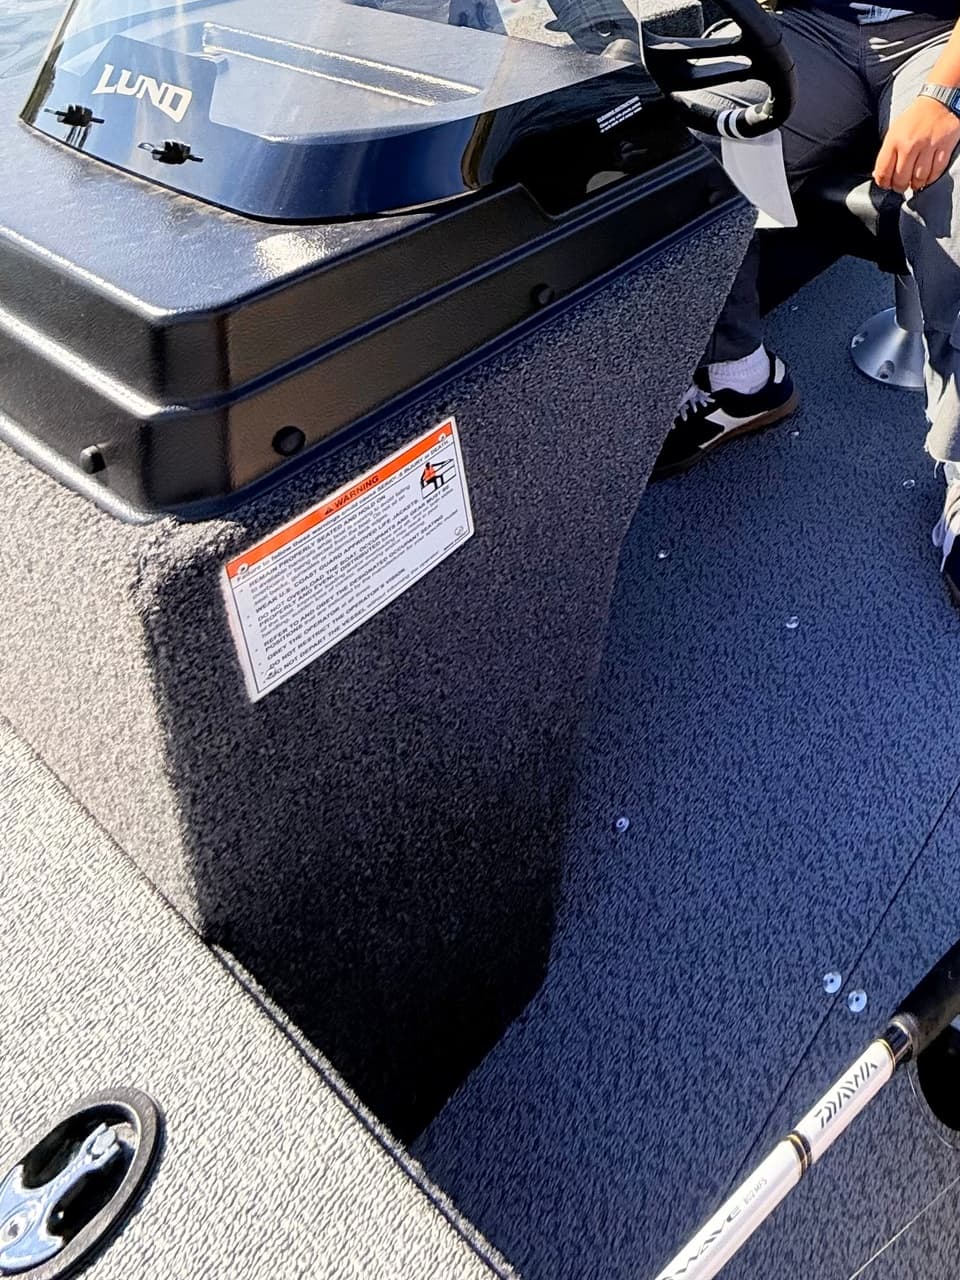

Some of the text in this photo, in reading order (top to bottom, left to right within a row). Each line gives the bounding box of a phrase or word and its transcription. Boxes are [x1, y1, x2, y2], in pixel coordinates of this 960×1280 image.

[91, 63, 193, 123] LUND
[311, 515, 340, 534] warnings
[430, 441, 448, 454] DEATH
[335, 476, 379, 508] WARNING
[248, 567, 277, 586] REMAIN
[278, 542, 316, 567] PROPERLY
[316, 524, 342, 543] SEATED
[258, 600, 297, 626] PROPERLY
[313, 571, 339, 589] EVENLY
[340, 542, 380, 571] DISTRIBUTED
[286, 575, 324, 601] OVERLOAD
[358, 525, 395, 551] OCCUPANTS
[293, 570, 317, 587] COAST
[318, 553, 342, 570] GUARD
[342, 528, 377, 553] APPROVED
[263, 628, 288, 645] REFER
[265, 624, 303, 651] POSITIONS
[299, 637, 326, 657] DEPART
[303, 607, 339, 634] OPERATOR
[814, 1061, 879, 1129] DAIWA
[662, 1207, 742, 1280] WAVE
